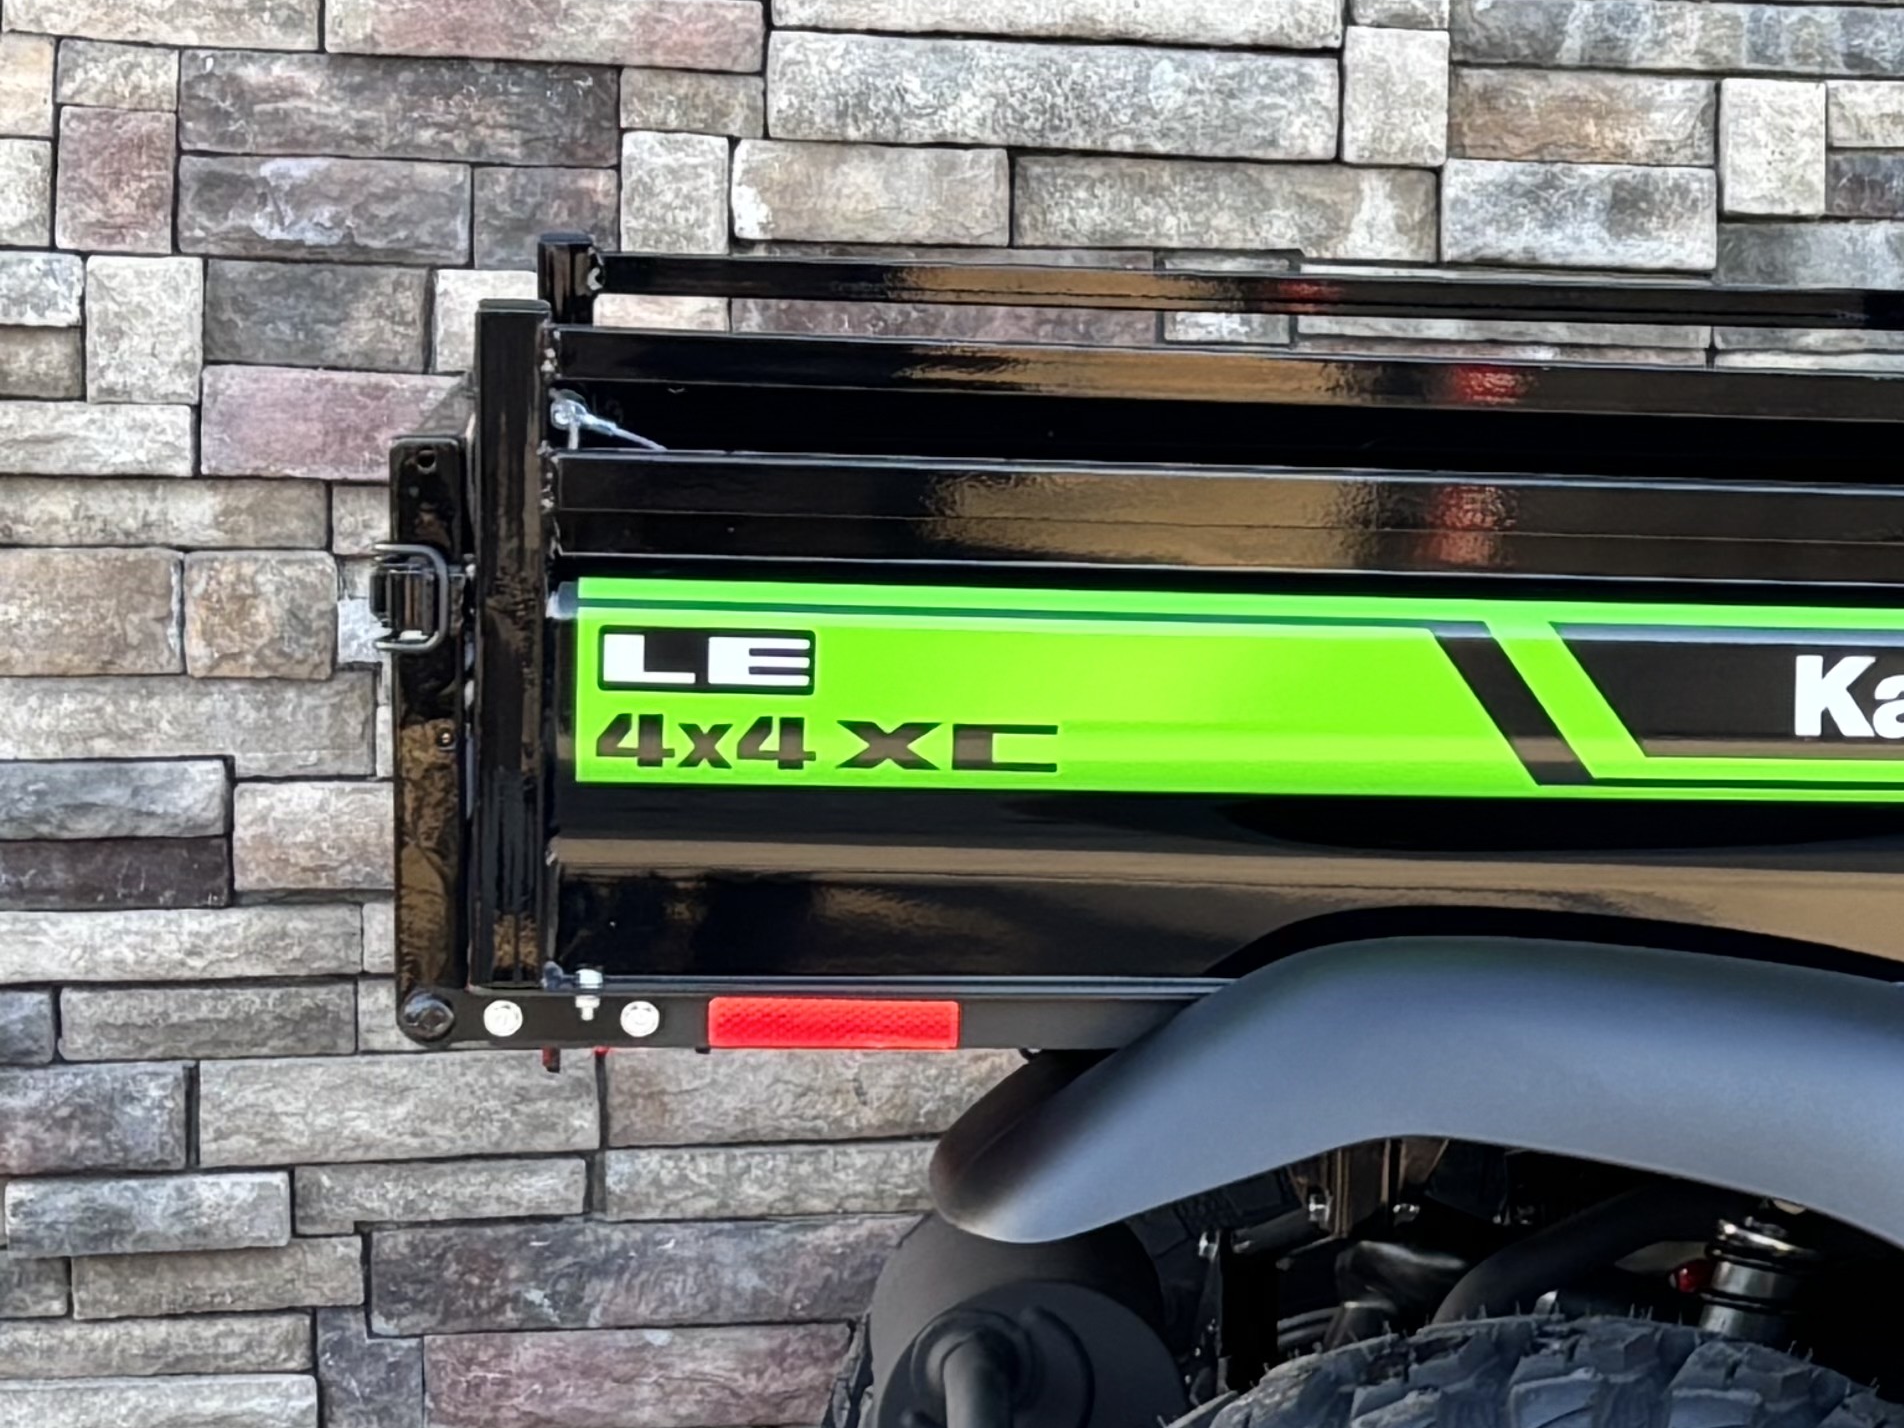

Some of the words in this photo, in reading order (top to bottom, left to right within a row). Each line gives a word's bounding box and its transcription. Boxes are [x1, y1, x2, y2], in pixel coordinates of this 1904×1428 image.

[603, 633, 811, 687] LE
[596, 713, 816, 770] 4x4
[836, 720, 1059, 772] XC
